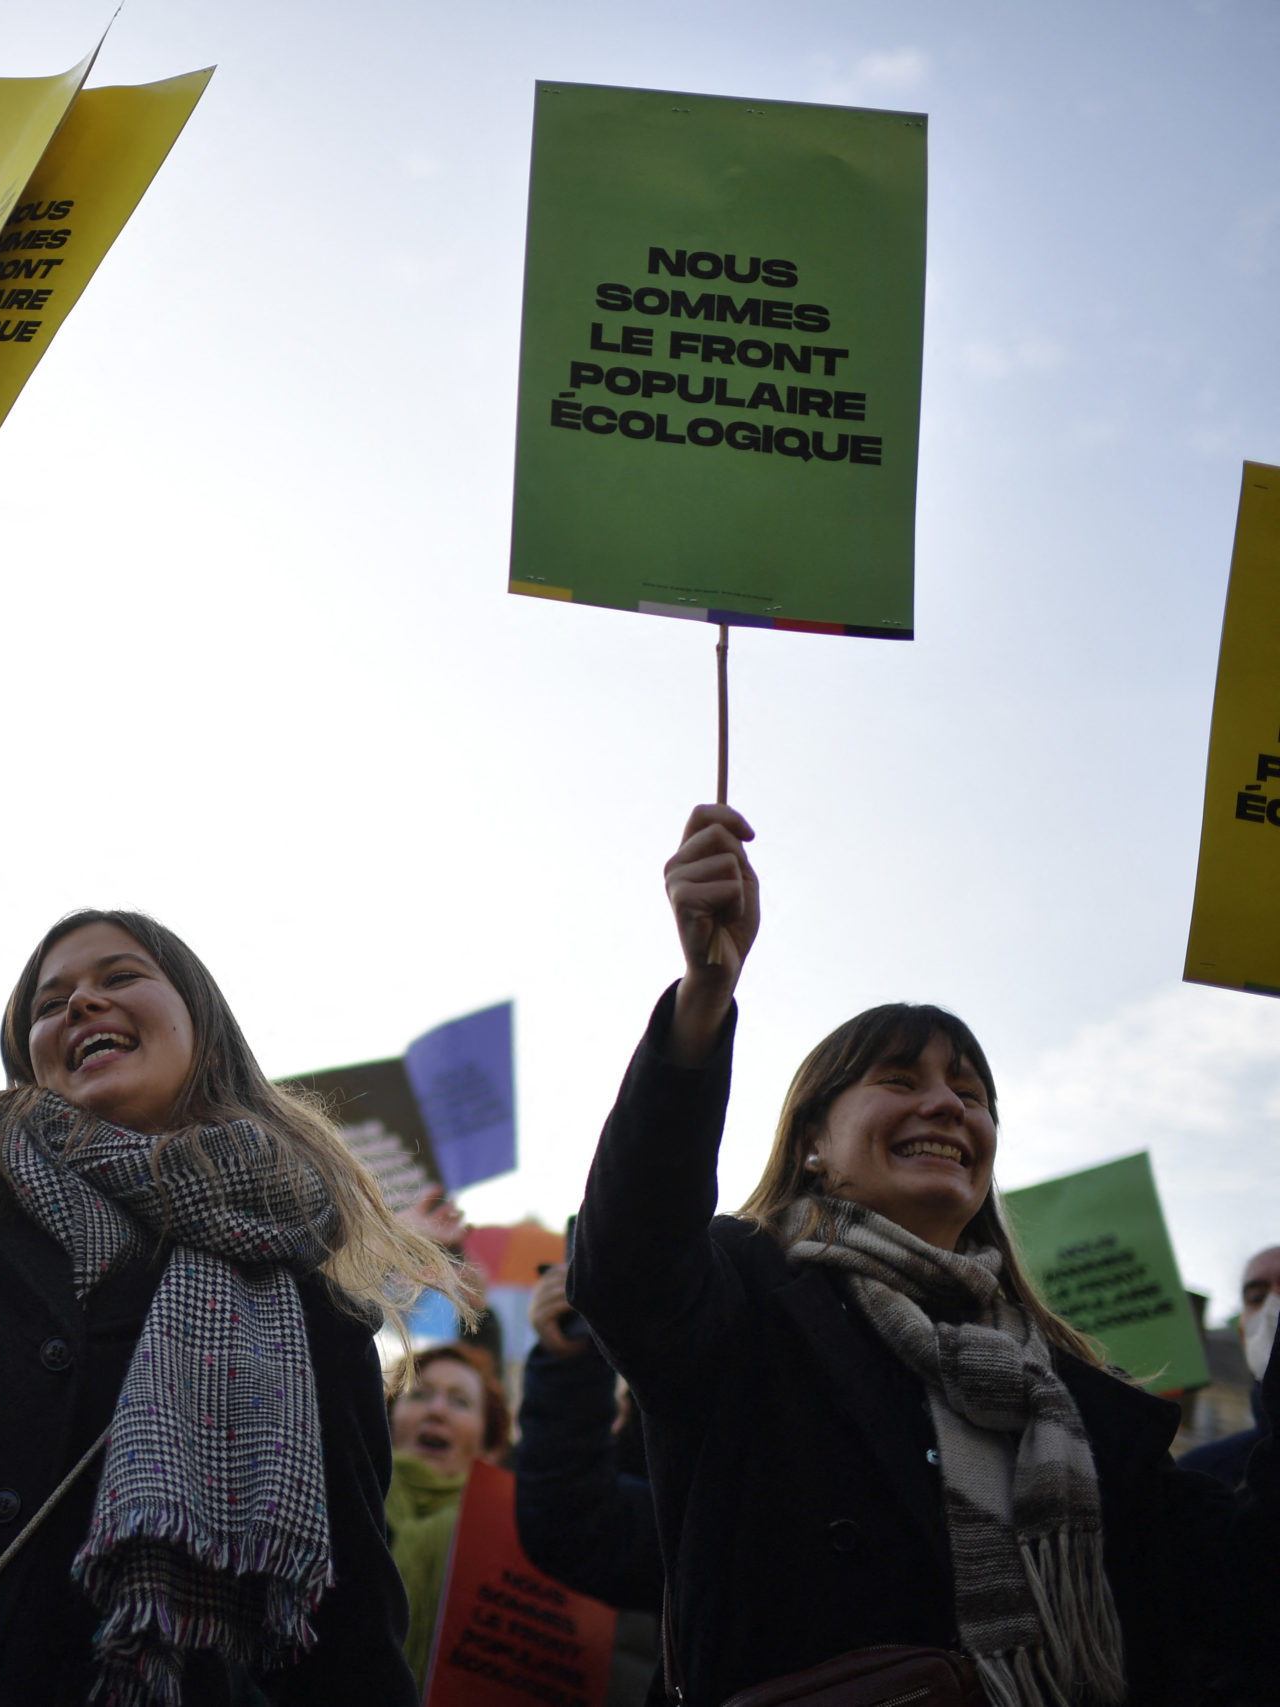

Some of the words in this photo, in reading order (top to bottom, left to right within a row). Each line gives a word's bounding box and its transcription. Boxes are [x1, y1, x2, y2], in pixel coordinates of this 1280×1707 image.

[6, 199, 74, 226] OUS
[647, 246, 799, 288] NOUS
[594, 282, 831, 333] SOMMES
[589, 321, 655, 357] LE
[668, 330, 850, 377] FRONT
[569, 360, 867, 422] POPULAIRE
[549, 391, 883, 467] ÉCOLOGIQUE
